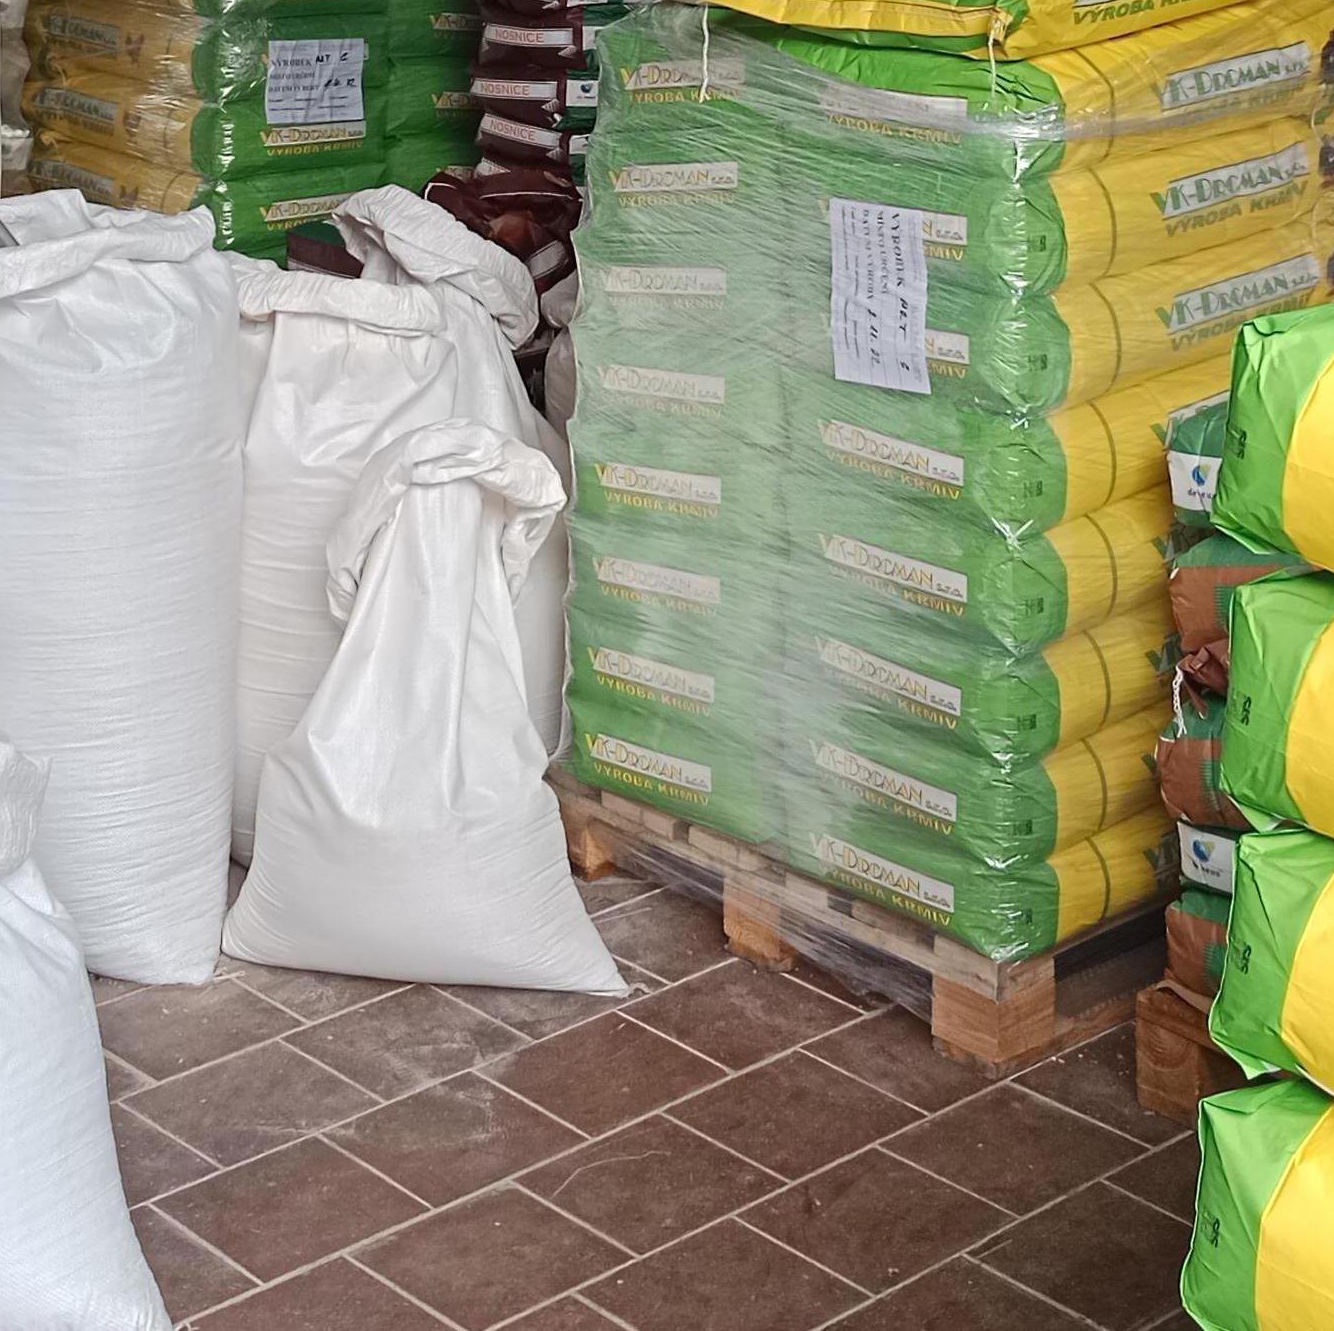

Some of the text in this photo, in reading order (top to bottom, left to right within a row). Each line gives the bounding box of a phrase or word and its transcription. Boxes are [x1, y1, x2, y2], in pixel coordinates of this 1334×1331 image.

[494, 29, 545, 43] NOSNICE
[480, 82, 530, 96] NOSNICE
[489, 119, 536, 142] NOSNICE
